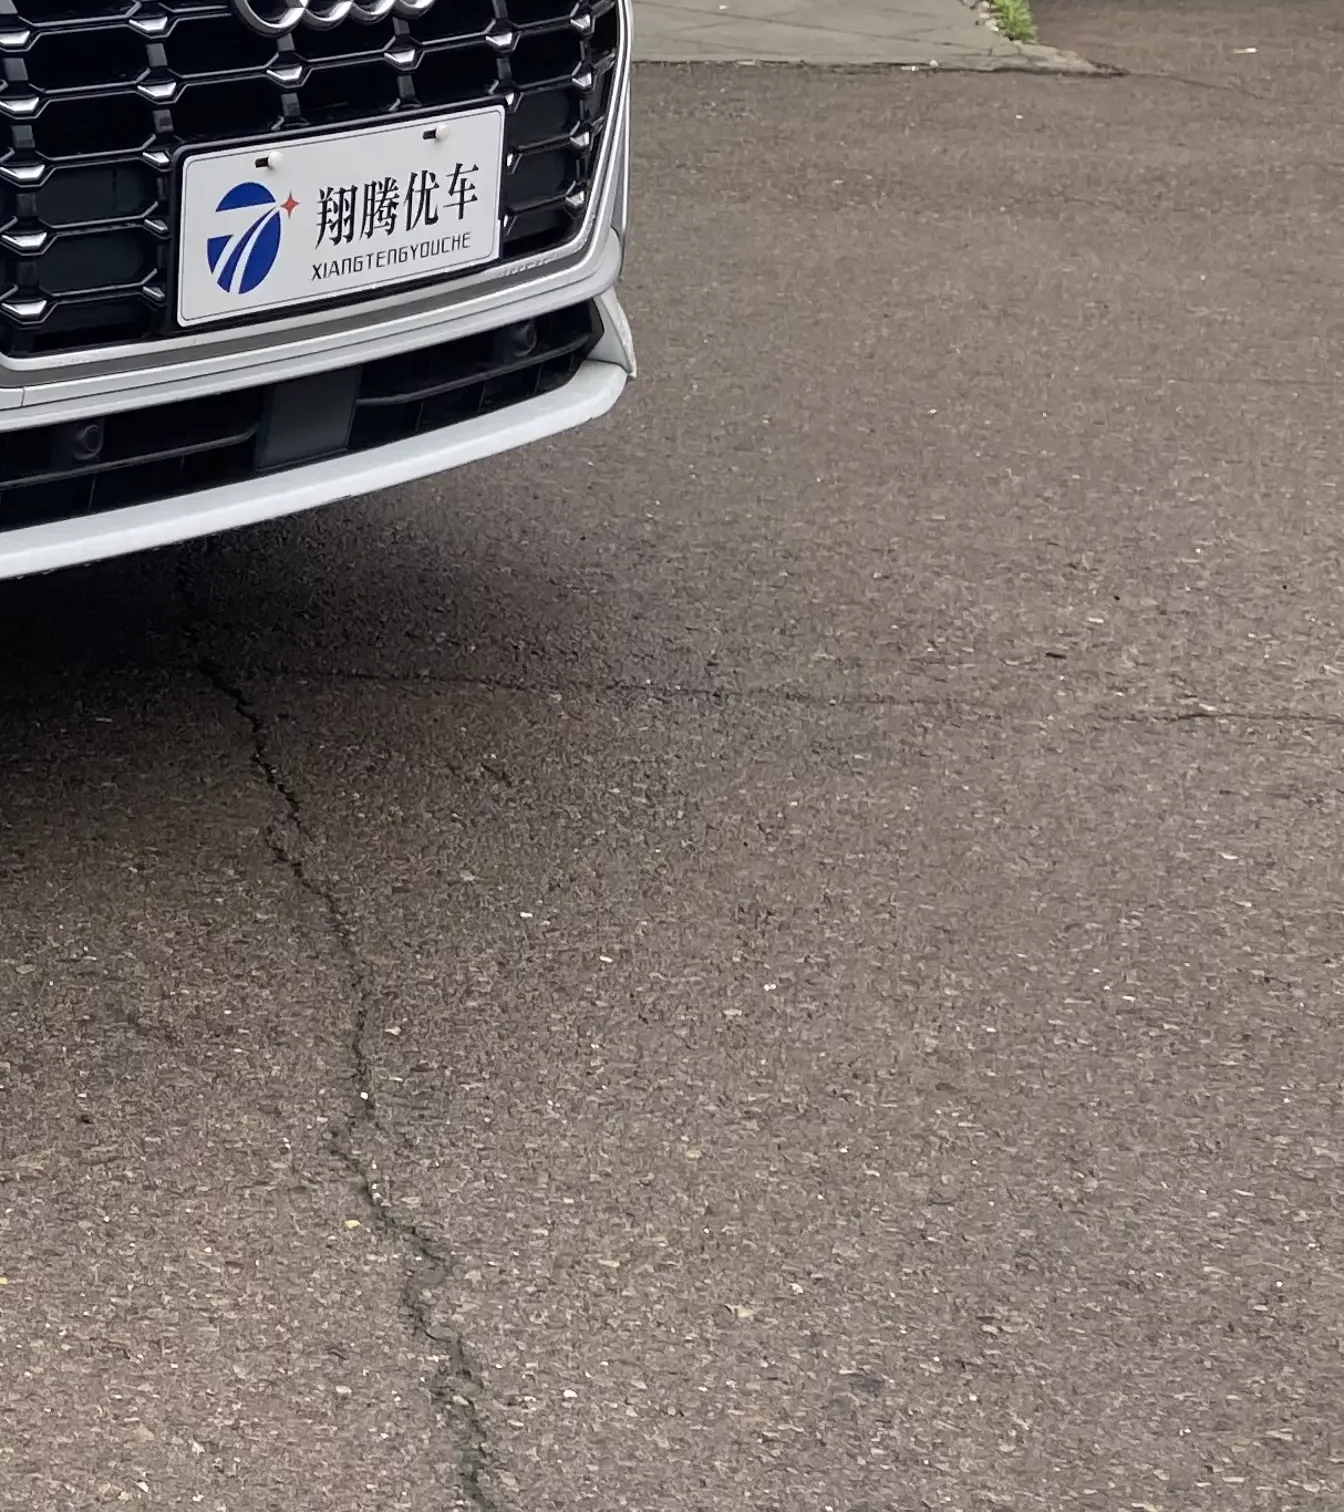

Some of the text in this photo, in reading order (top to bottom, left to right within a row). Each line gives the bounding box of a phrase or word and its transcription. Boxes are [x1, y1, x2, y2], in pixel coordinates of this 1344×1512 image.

[314, 162, 479, 250] 翔腾优车
[311, 232, 472, 281] XIANGTENGYOUCHE
